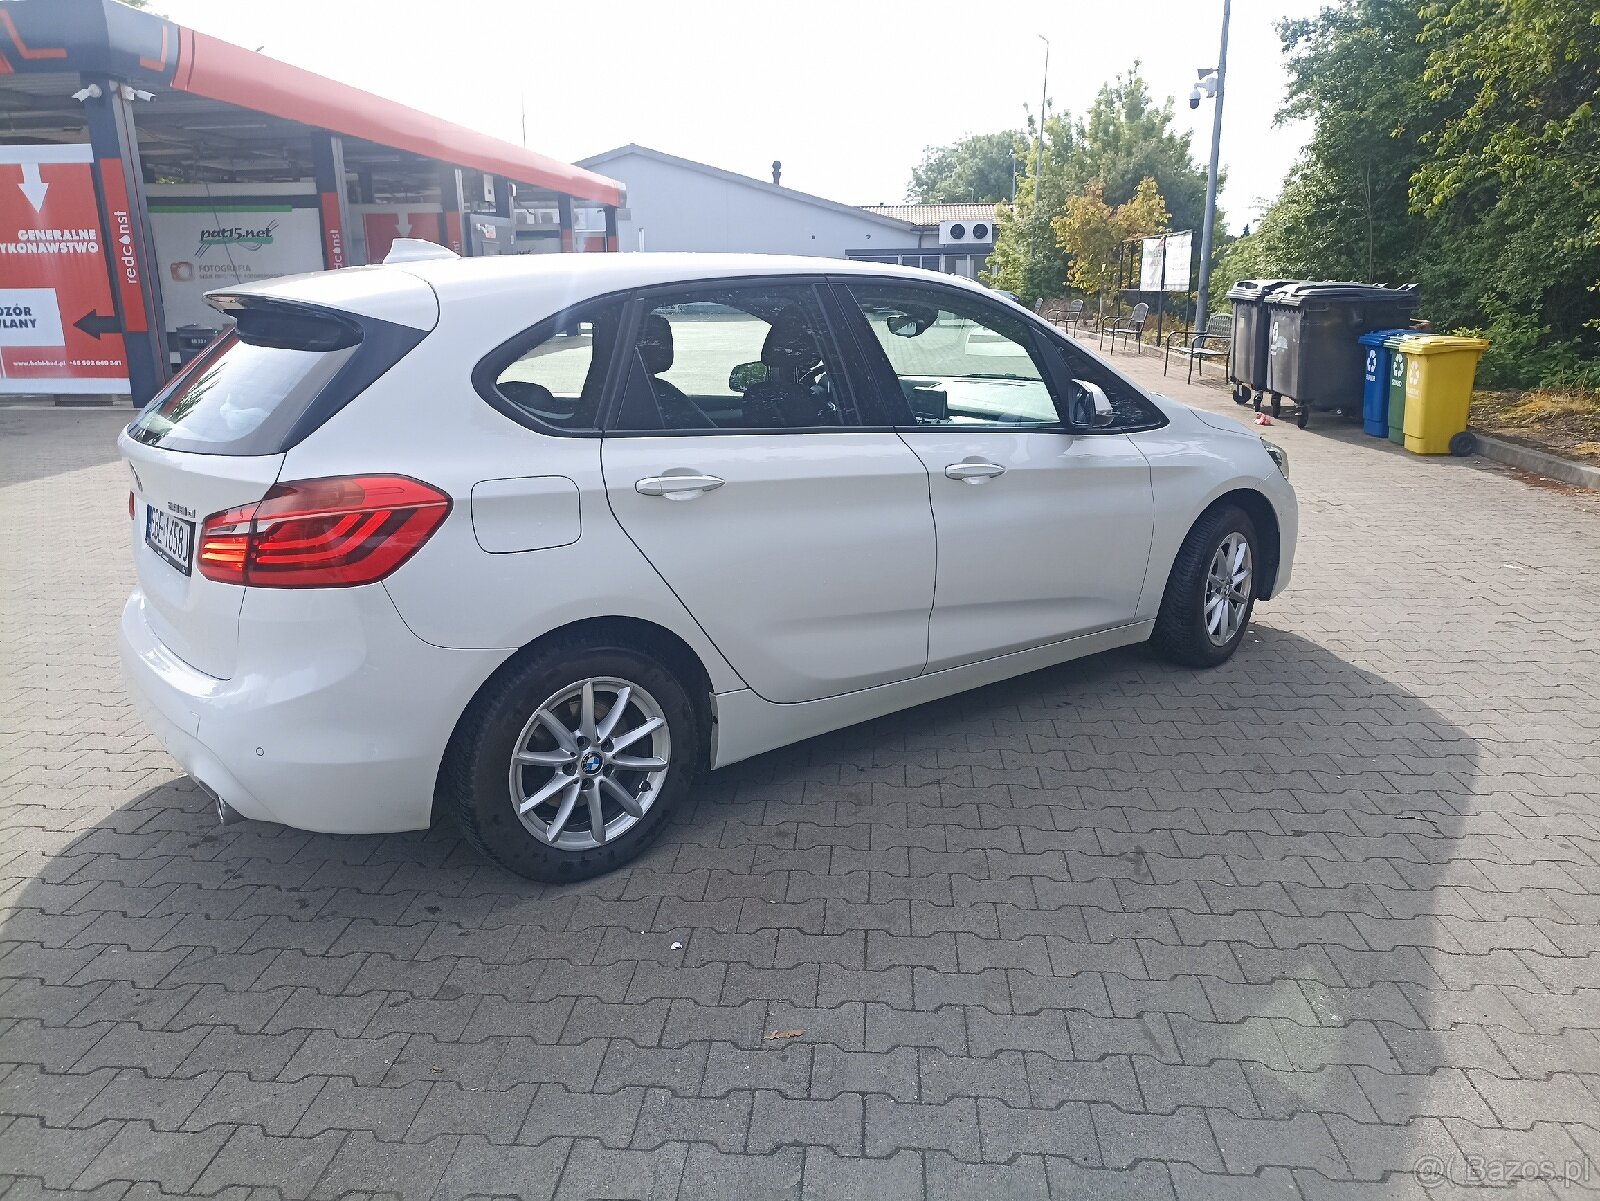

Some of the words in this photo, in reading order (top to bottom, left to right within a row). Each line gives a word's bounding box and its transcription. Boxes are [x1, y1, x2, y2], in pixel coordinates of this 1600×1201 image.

[17, 229, 97, 240] GENERALNE
[200, 227, 273, 241] pat15.net
[0, 241, 99, 254] YKONAWSTWO
[198, 264, 252, 273] FOTOGRAFIA
[0, 318, 37, 328] LANY
